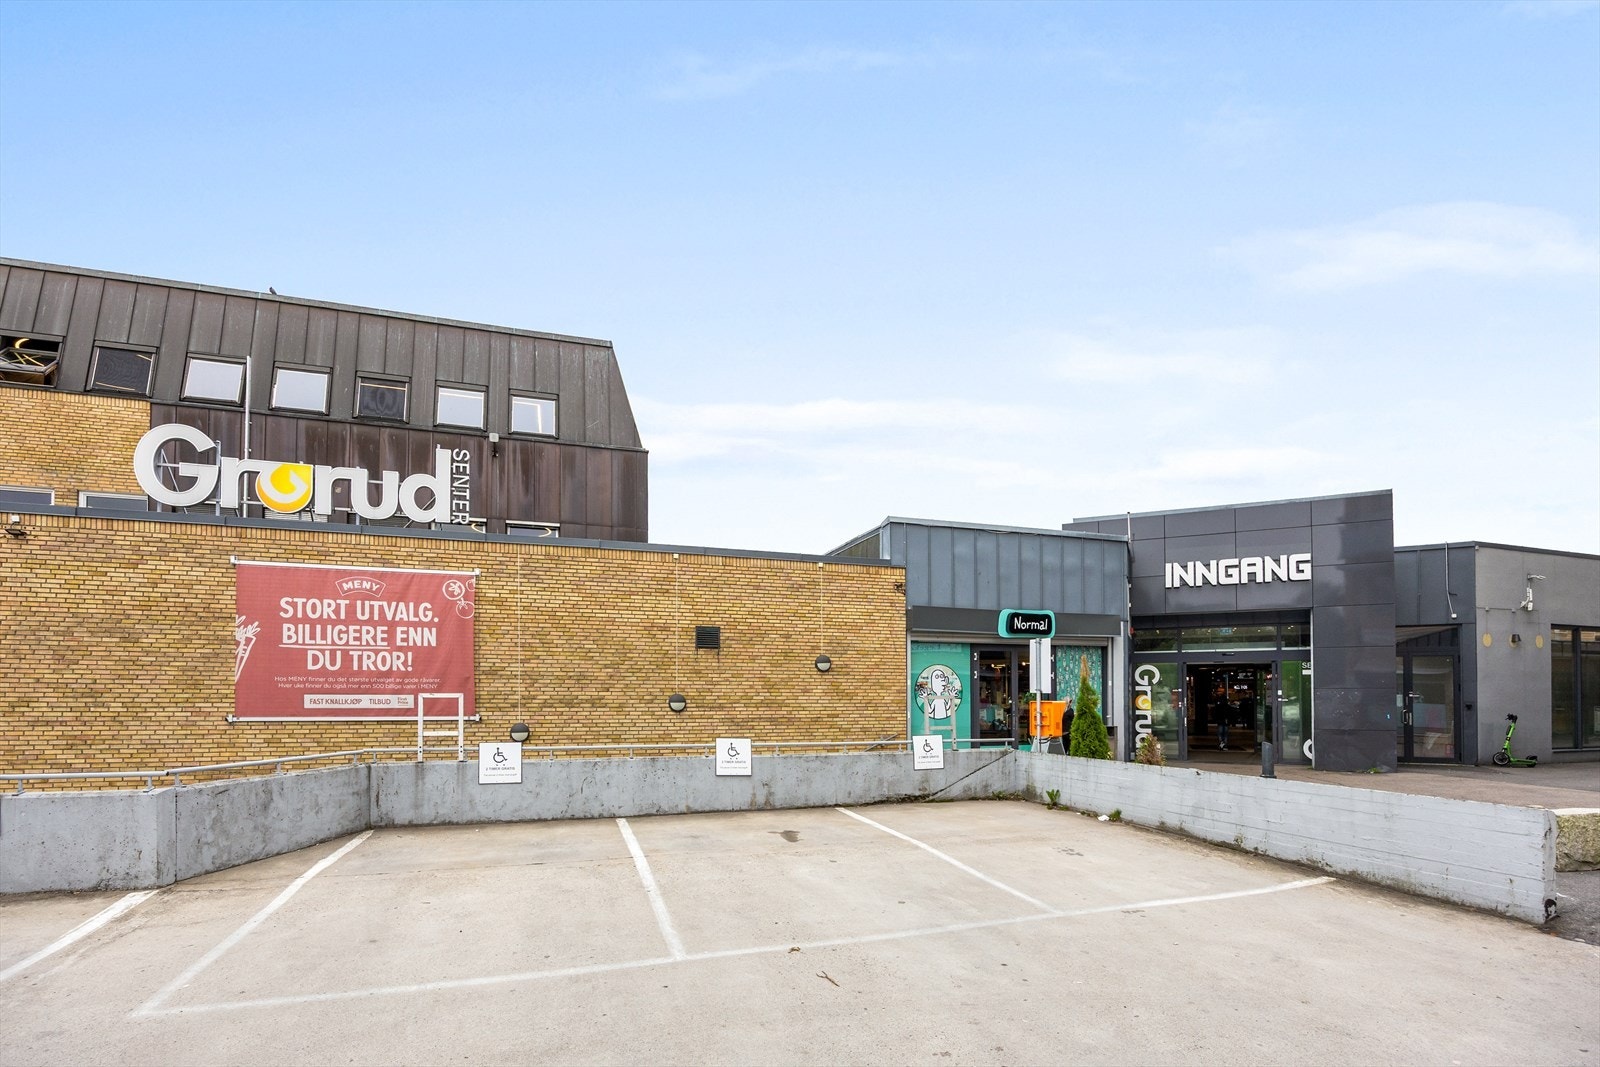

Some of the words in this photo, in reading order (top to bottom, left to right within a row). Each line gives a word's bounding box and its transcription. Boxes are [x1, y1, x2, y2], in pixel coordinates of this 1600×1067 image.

[452, 448, 471, 525] SENTER
[1165, 553, 1312, 588] INNGANG
[342, 580, 381, 592] MENY
[279, 597, 350, 619] STORT
[356, 600, 439, 623] UTVALG.
[283, 623, 388, 646] BILLIGERE
[396, 626, 437, 647] ENN
[1013, 616, 1049, 631] Normal
[307, 649, 342, 671] DU
[349, 650, 413, 672] TROR!
